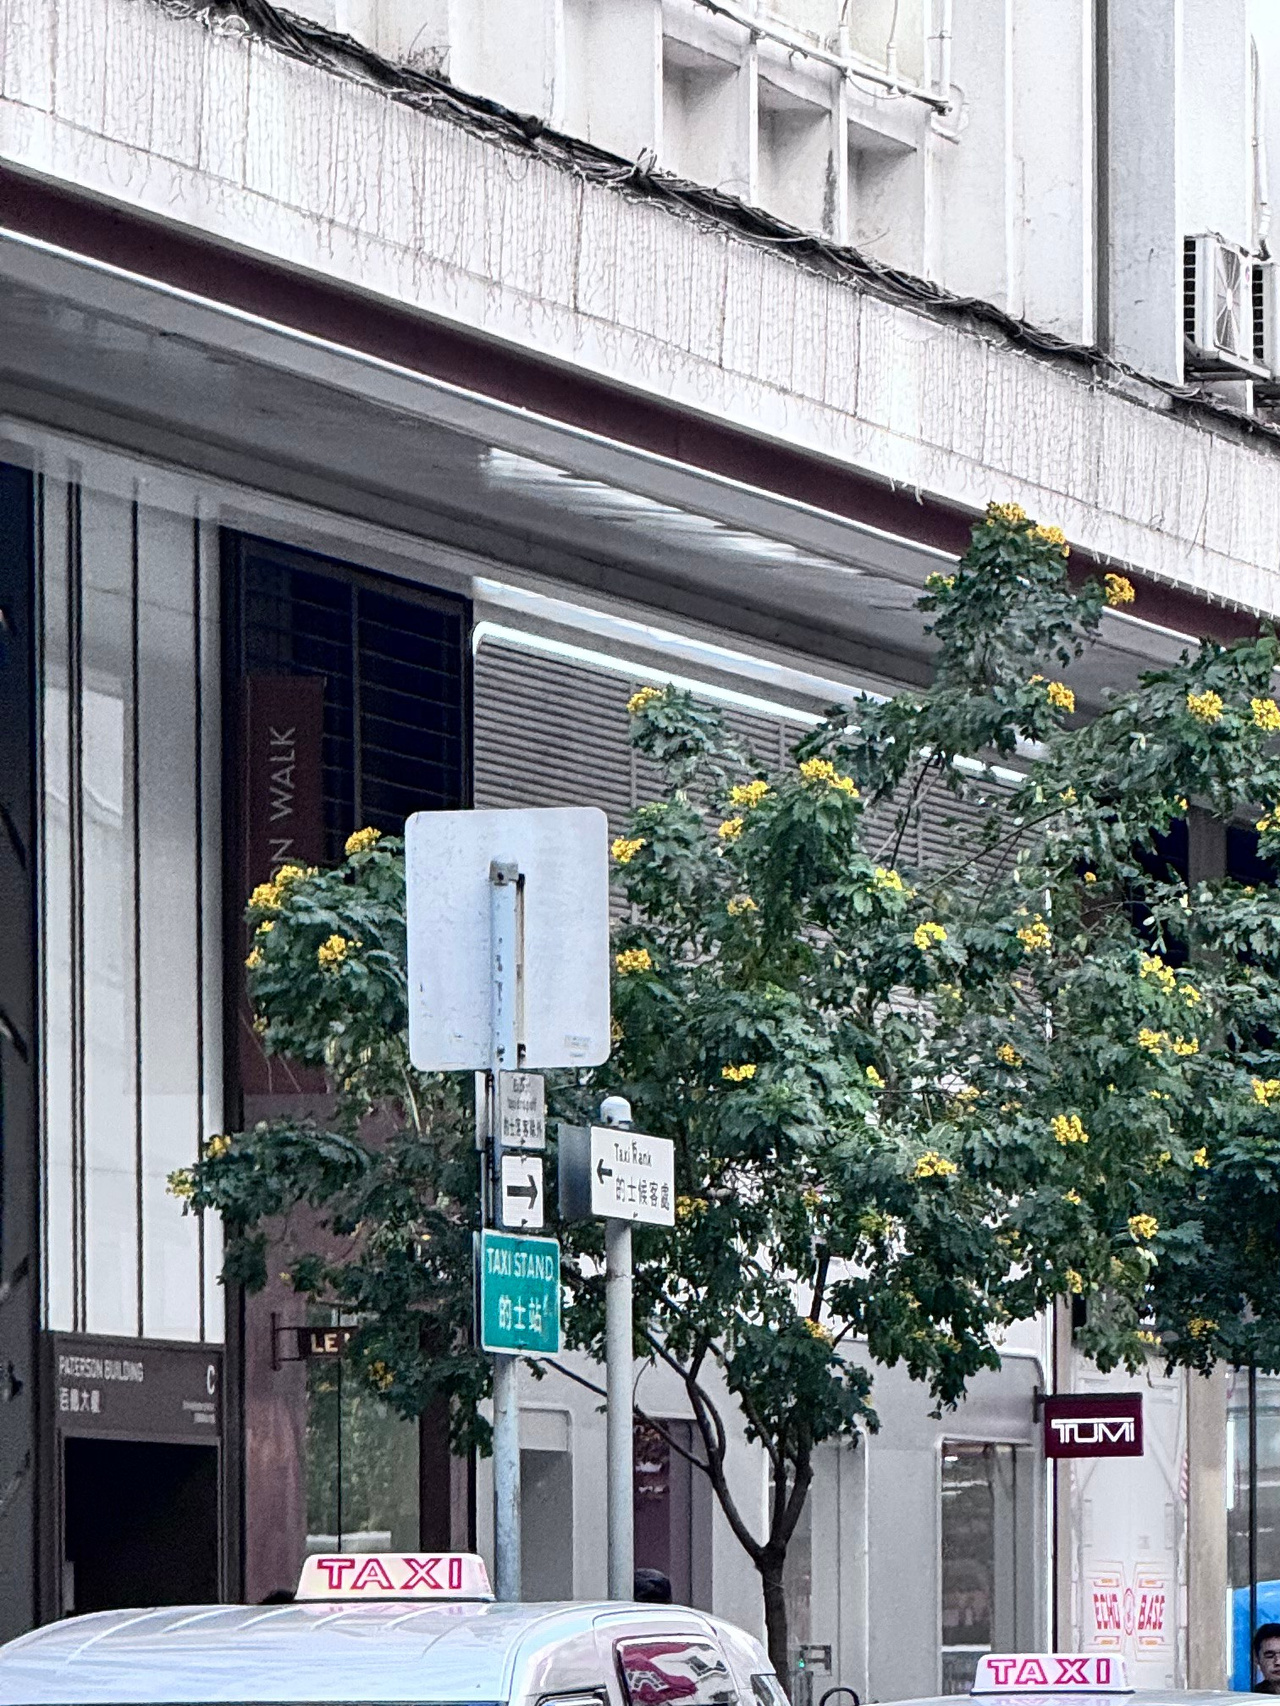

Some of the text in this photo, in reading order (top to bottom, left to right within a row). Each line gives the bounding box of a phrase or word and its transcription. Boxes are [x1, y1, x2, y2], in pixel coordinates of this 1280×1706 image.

[269, 726, 296, 822] WALK
[614, 1139, 652, 1168] Taxi Rank
[615, 1174, 670, 1211] 的士候客處
[486, 1247, 554, 1281] TAXI STAND
[498, 1293, 543, 1334] 的士站
[58, 1354, 144, 1382] PATERSON BUILDING
[1051, 1417, 1135, 1443] TUMI
[317, 1557, 462, 1590] TAXI
[987, 1657, 1111, 1685] TAXI
